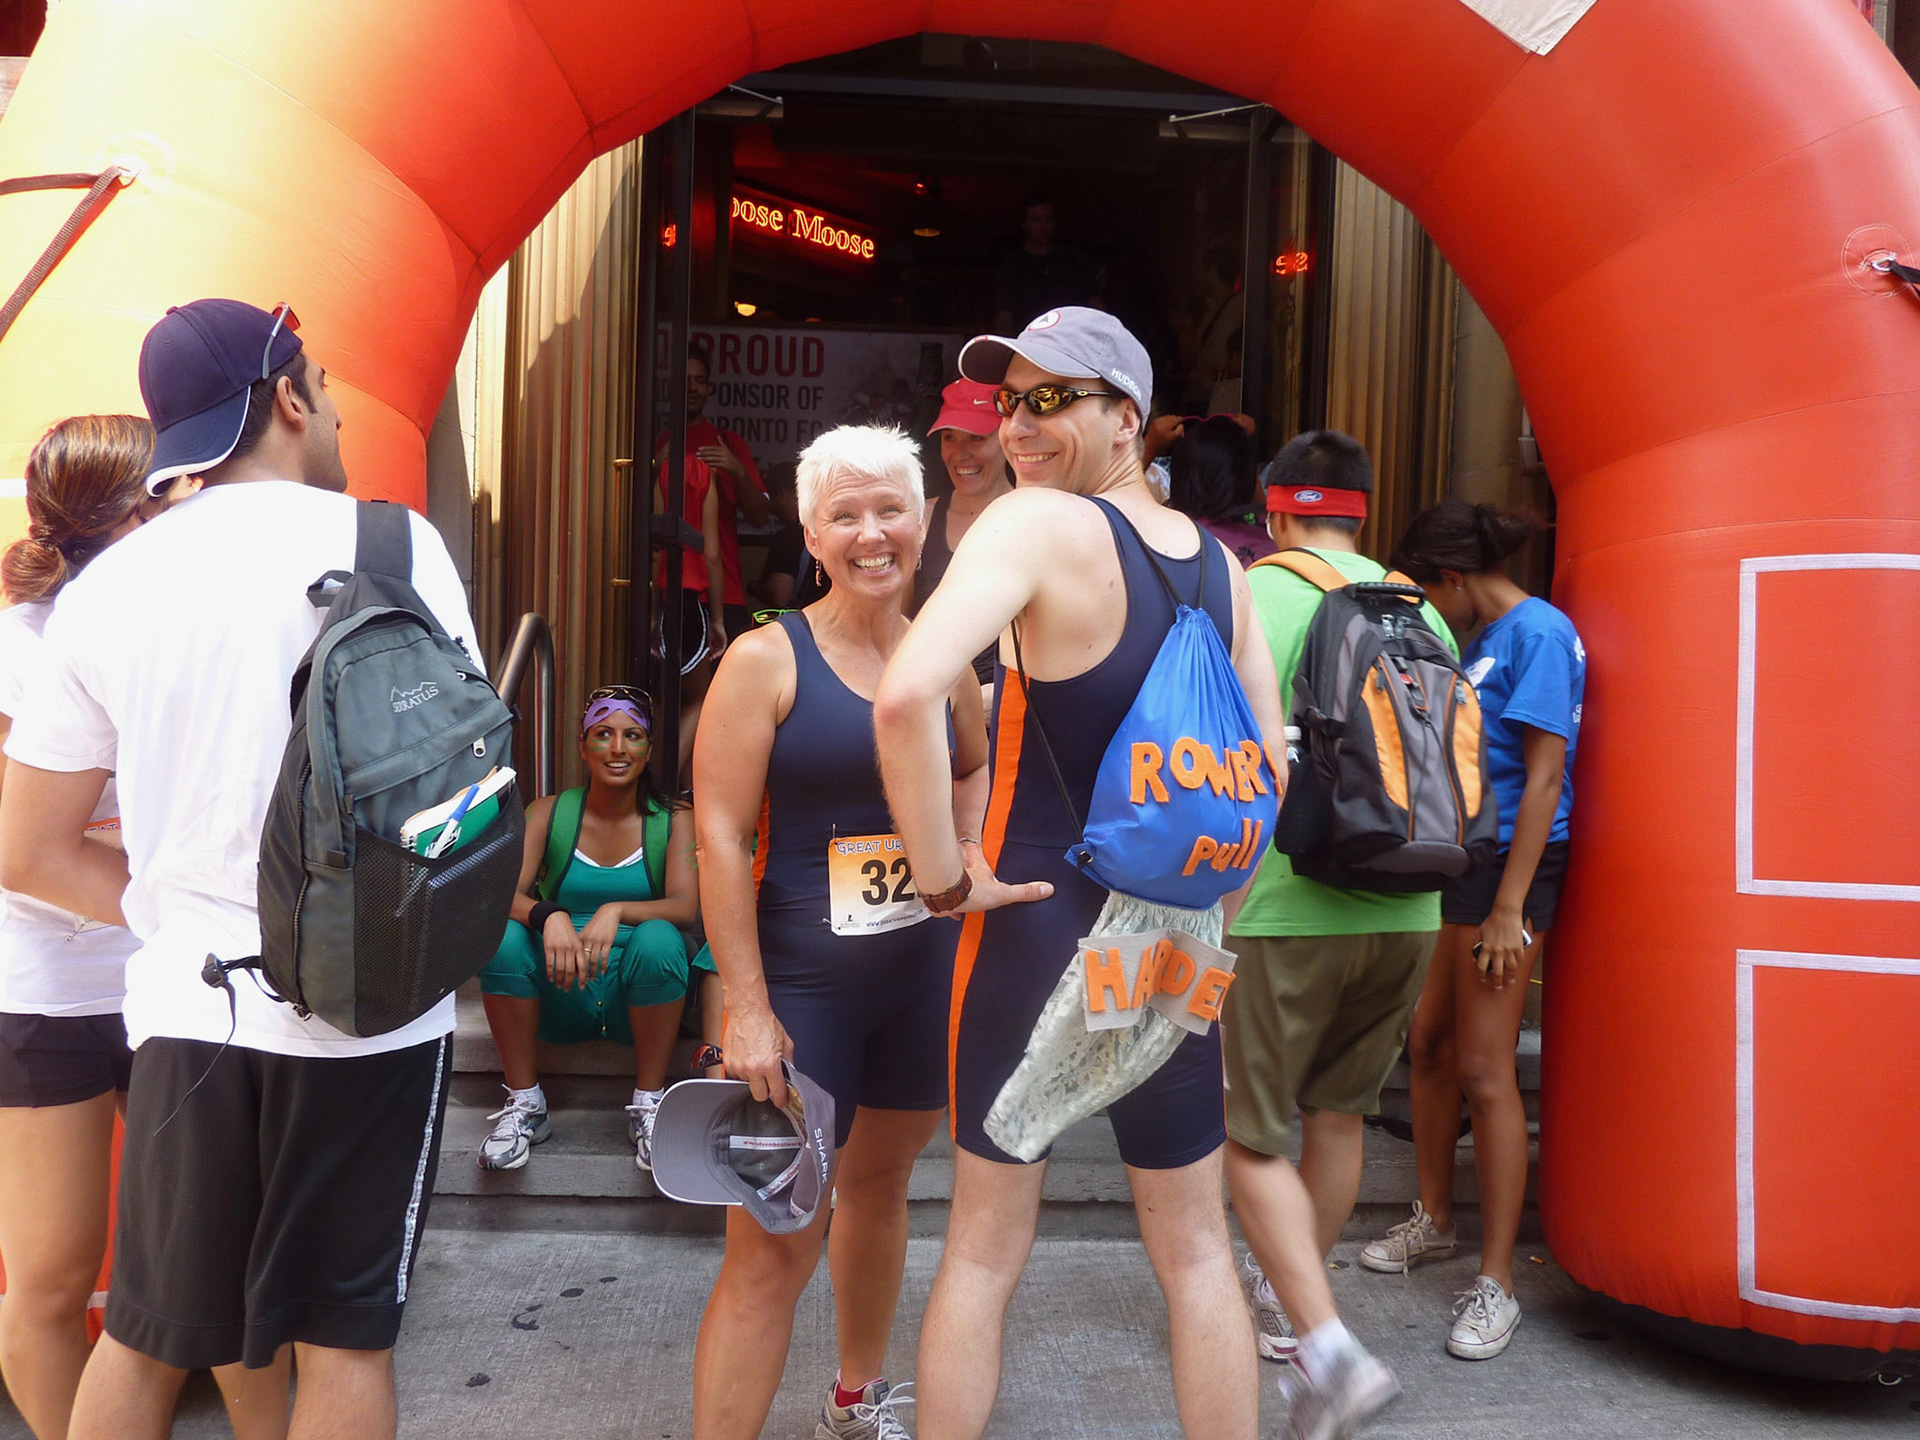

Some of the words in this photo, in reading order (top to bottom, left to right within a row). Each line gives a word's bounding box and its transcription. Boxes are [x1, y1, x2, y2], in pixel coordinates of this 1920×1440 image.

[792, 208, 875, 259] Moose
[797, 386, 825, 410] OF
[392, 685, 439, 713] SERRATUS
[836, 839, 881, 855] GREAT
[1181, 816, 1264, 877] Pull
[860, 857, 921, 906] 32
[814, 1127, 829, 1185] SHARK
